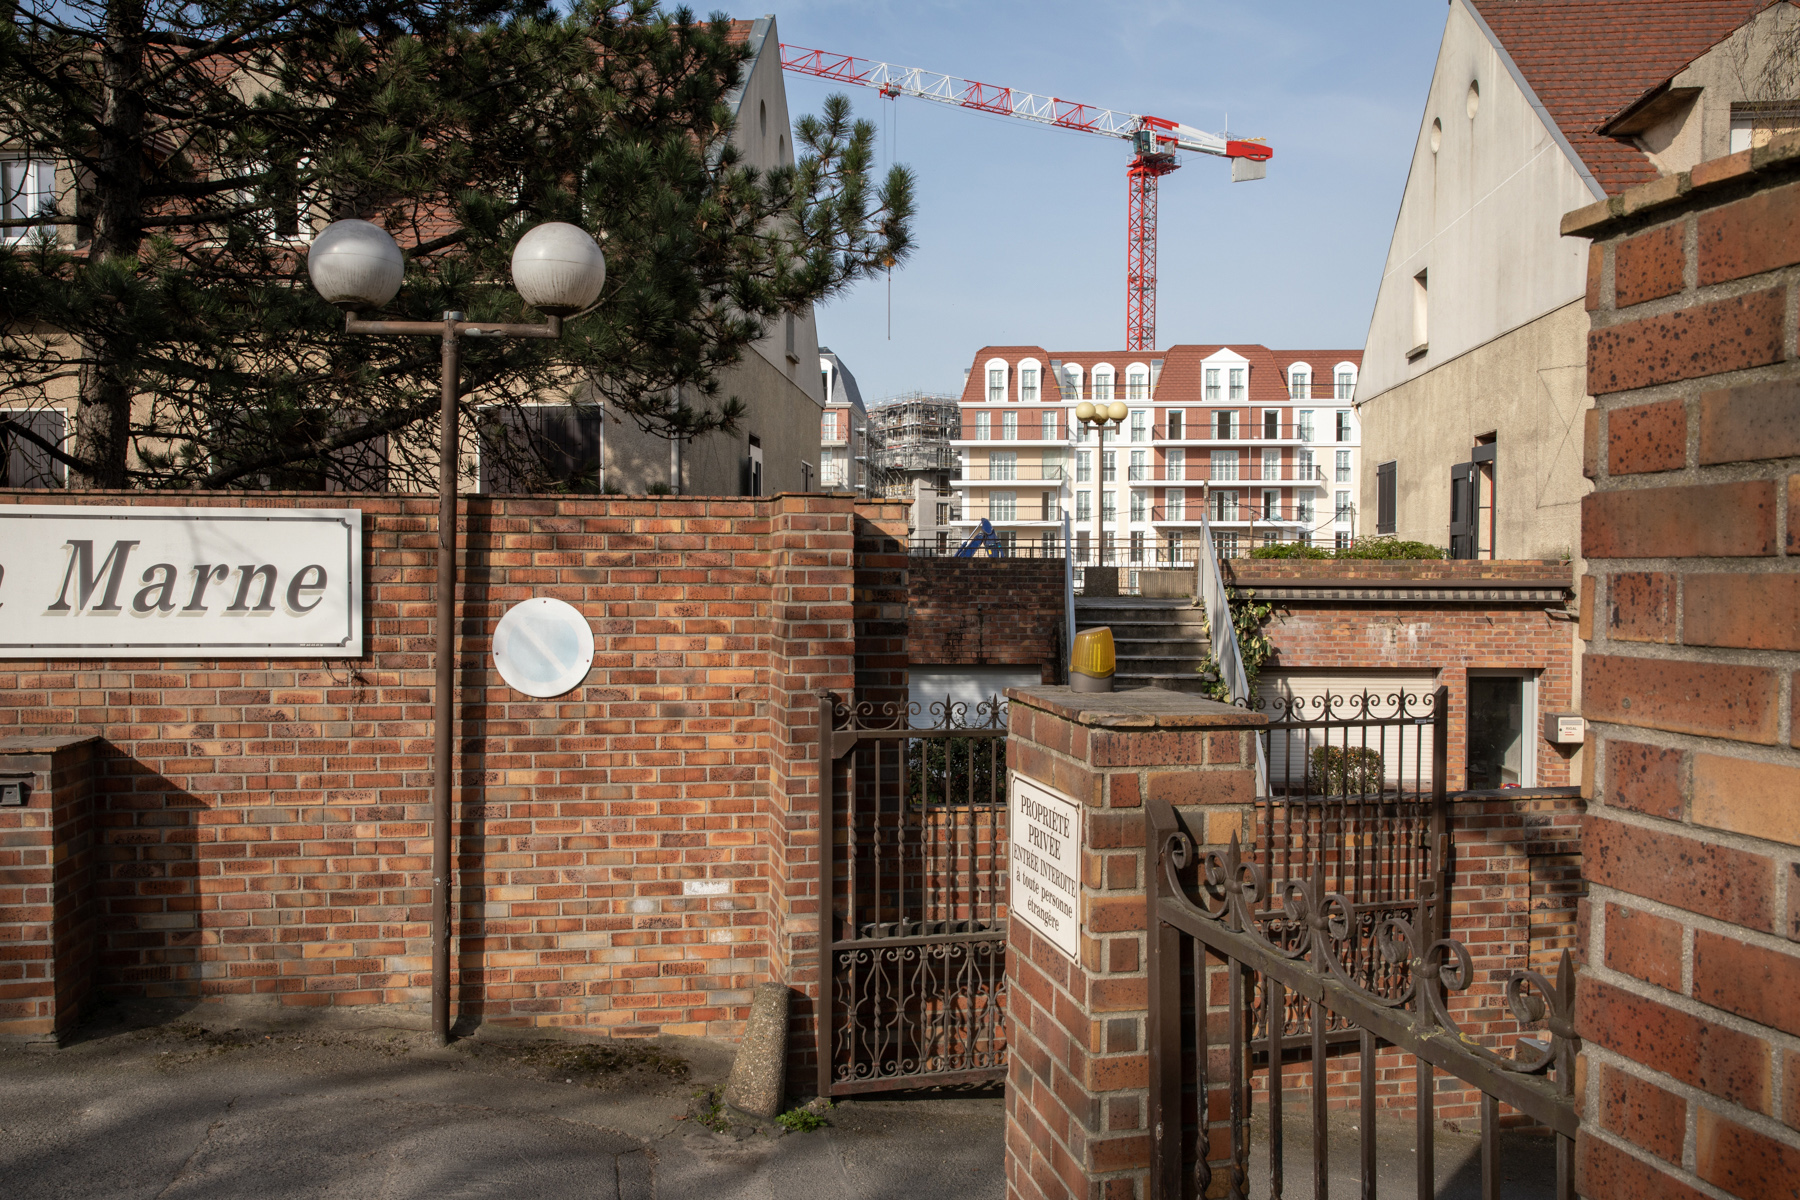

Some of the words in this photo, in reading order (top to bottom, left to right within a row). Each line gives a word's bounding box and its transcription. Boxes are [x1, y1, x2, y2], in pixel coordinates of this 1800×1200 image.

[45, 539, 328, 614] Marne
[1020, 794, 1070, 839] PROPRIÉTÉ
[1028, 823, 1061, 861] PRIVÉE
[1013, 842, 1039, 873] ENTRÉE
[1040, 858, 1076, 898] INTERDITE
[1016, 866, 1021, 882] à
[1022, 873, 1039, 895] toute
[1041, 886, 1073, 919] personne
[1027, 895, 1060, 932] étrangère
